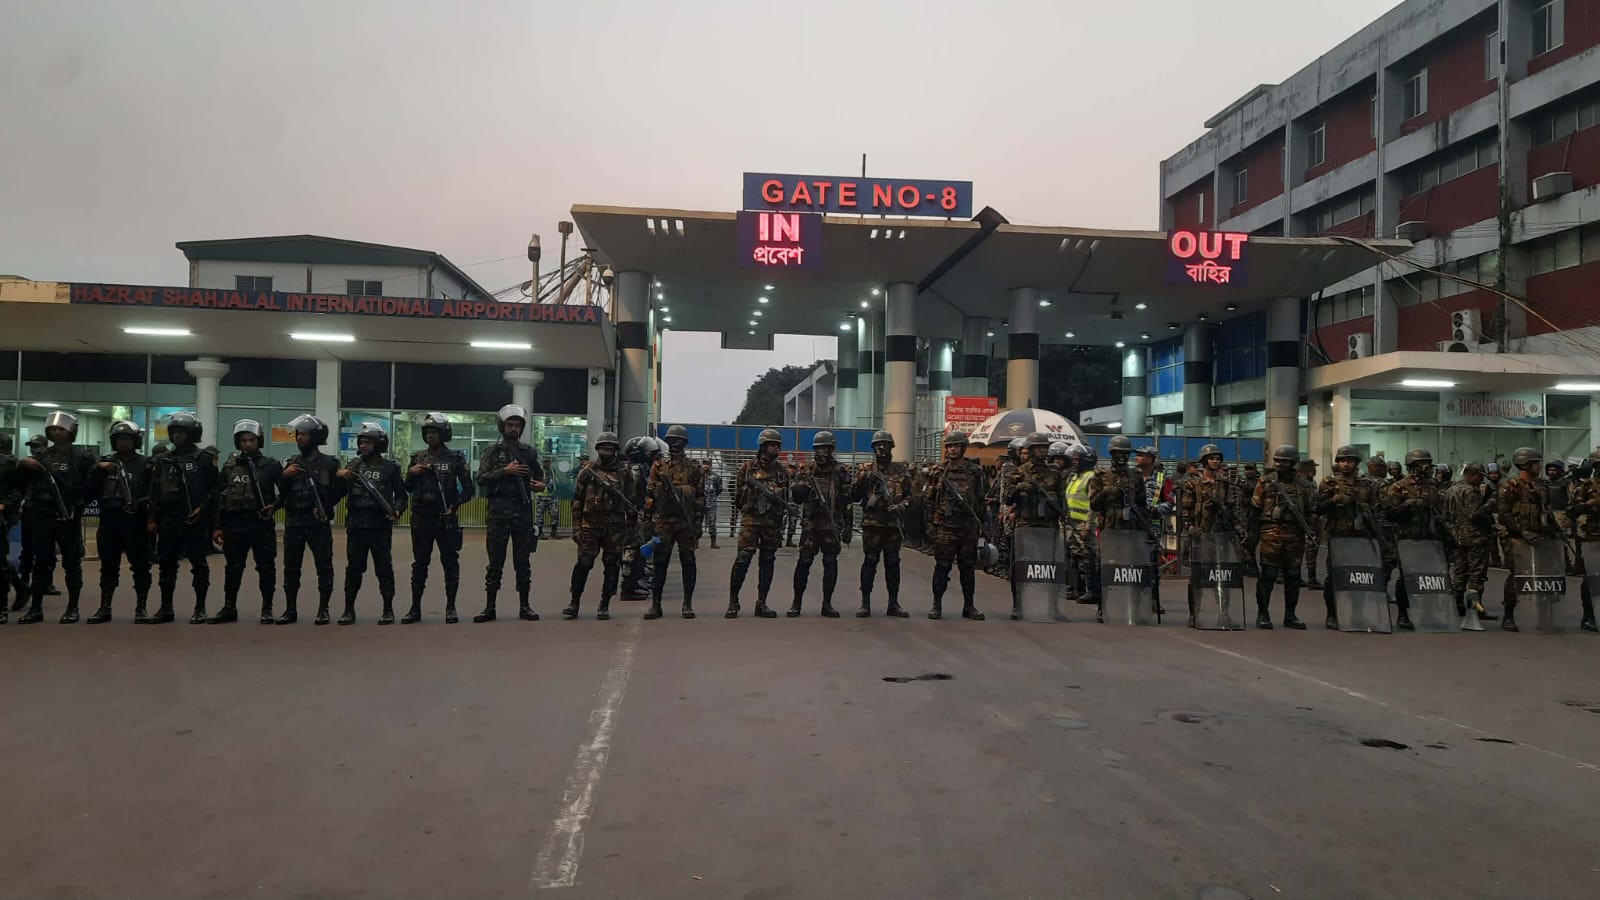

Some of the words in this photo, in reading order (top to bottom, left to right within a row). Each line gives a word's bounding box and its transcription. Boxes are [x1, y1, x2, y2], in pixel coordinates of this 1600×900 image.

[761, 179, 857, 207] GATE
[872, 184, 957, 210] NO-8
[759, 213, 800, 242] IN
[1171, 230, 1248, 259] OUT
[753, 246, 804, 265] প্রবেশ
[1185, 260, 1232, 284] বাহির
[73, 286, 156, 304] HAZRAT
[161, 288, 281, 310] SHAHJALAL
[287, 294, 434, 316] INTERNATIONAL
[440, 301, 524, 320] AIRPORT
[529, 305, 597, 323] DHAKA
[1047, 433, 1075, 441] ALTON
[1027, 564, 1057, 579] ARMY
[1113, 567, 1143, 583] ARMY
[1208, 569, 1233, 582] ARMY
[1349, 572, 1374, 585] ARMY
[1418, 575, 1446, 590] ARMY
[1521, 580, 1564, 592] ARMY
